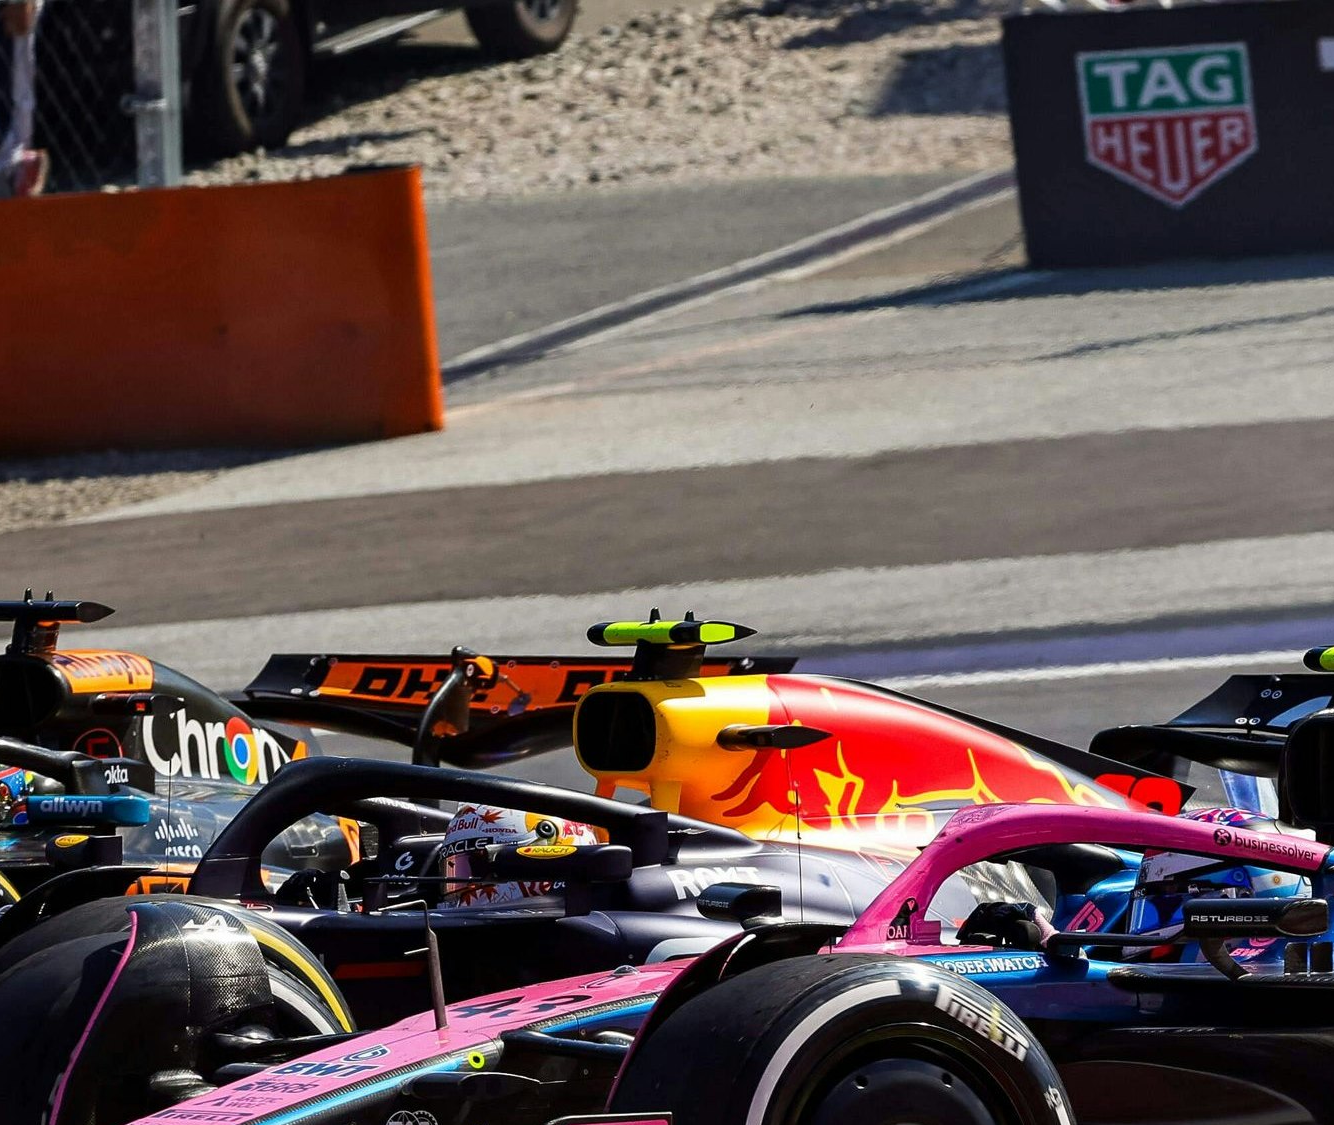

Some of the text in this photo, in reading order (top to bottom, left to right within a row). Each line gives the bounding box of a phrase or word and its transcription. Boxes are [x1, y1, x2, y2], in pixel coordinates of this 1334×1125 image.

[1092, 54, 1237, 109] TAG
[1095, 117, 1246, 194] HEUER
[103, 765, 129, 785] okta
[39, 796, 104, 817] allwyn
[457, 817, 479, 831] Bull
[1233, 831, 1318, 863] businessolver
[666, 866, 762, 900] ROKT
[934, 983, 1031, 1063] PIRELLI
[270, 1061, 382, 1079] BWT
[152, 1109, 254, 1123] PIRELLI
